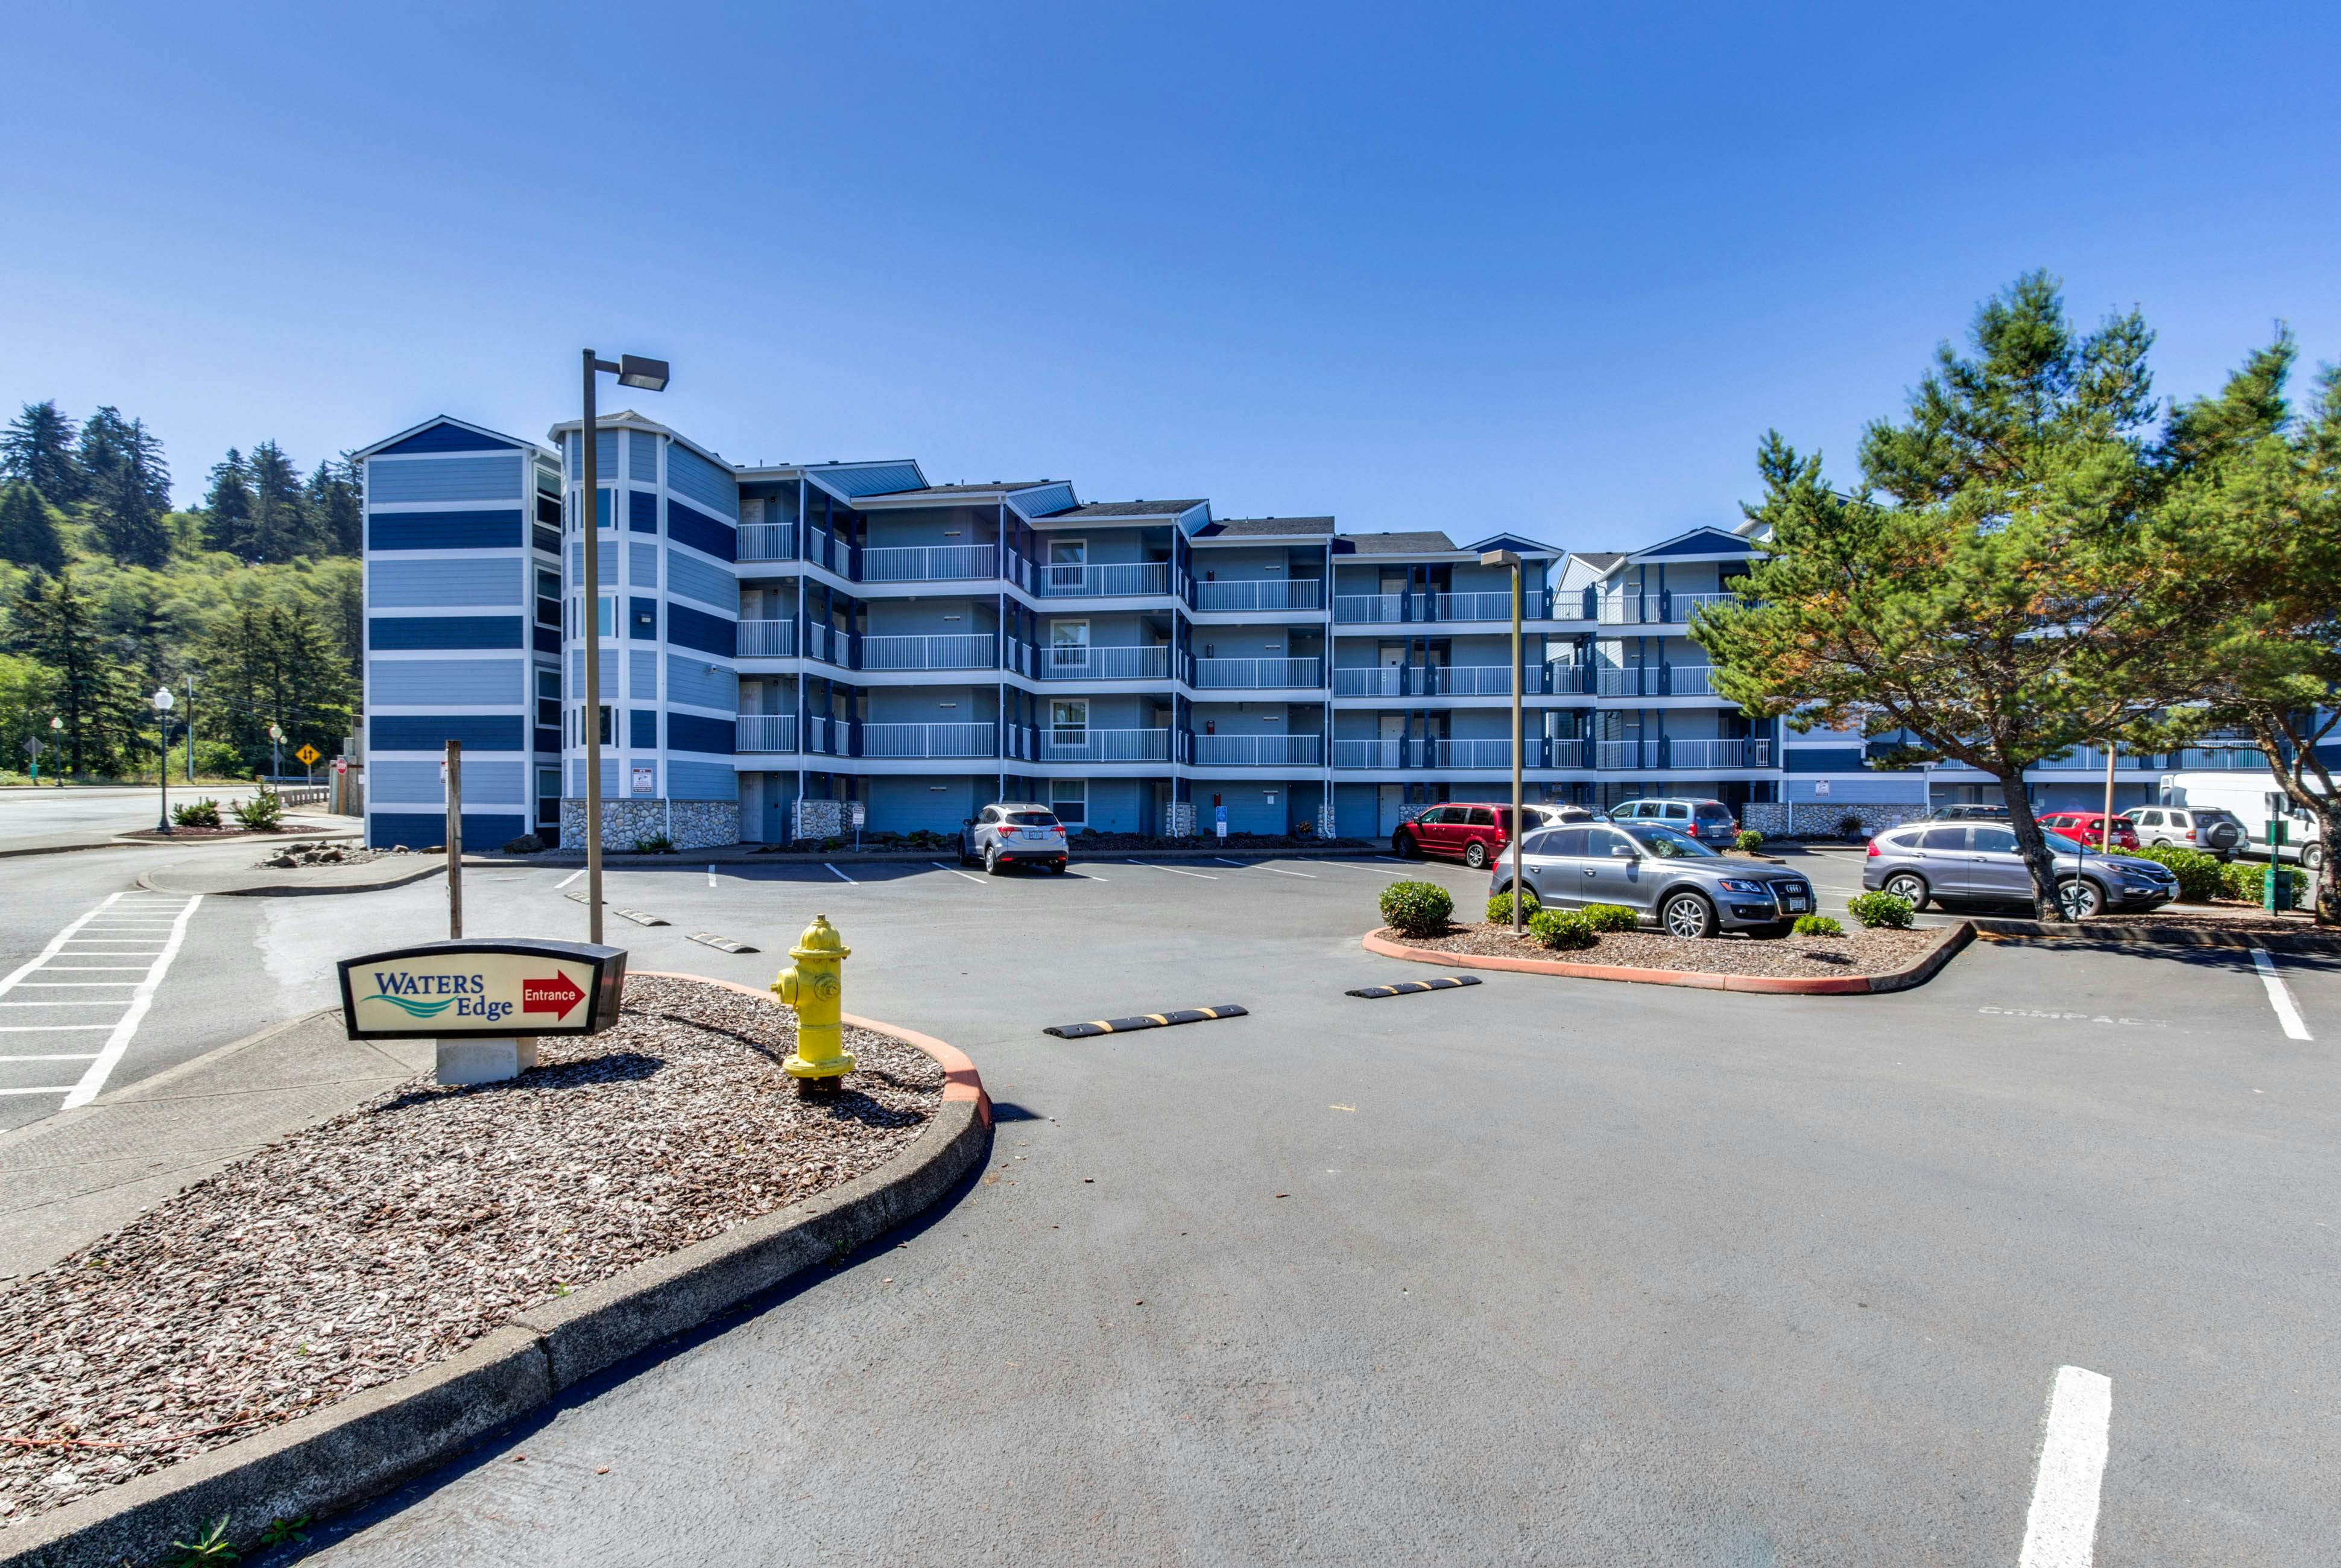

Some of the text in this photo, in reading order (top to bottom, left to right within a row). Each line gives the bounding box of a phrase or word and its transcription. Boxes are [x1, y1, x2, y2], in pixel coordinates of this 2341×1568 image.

[374, 972, 484, 994] WATERS
[525, 989, 575, 1001] Entrance
[456, 995, 513, 1021] Edge
